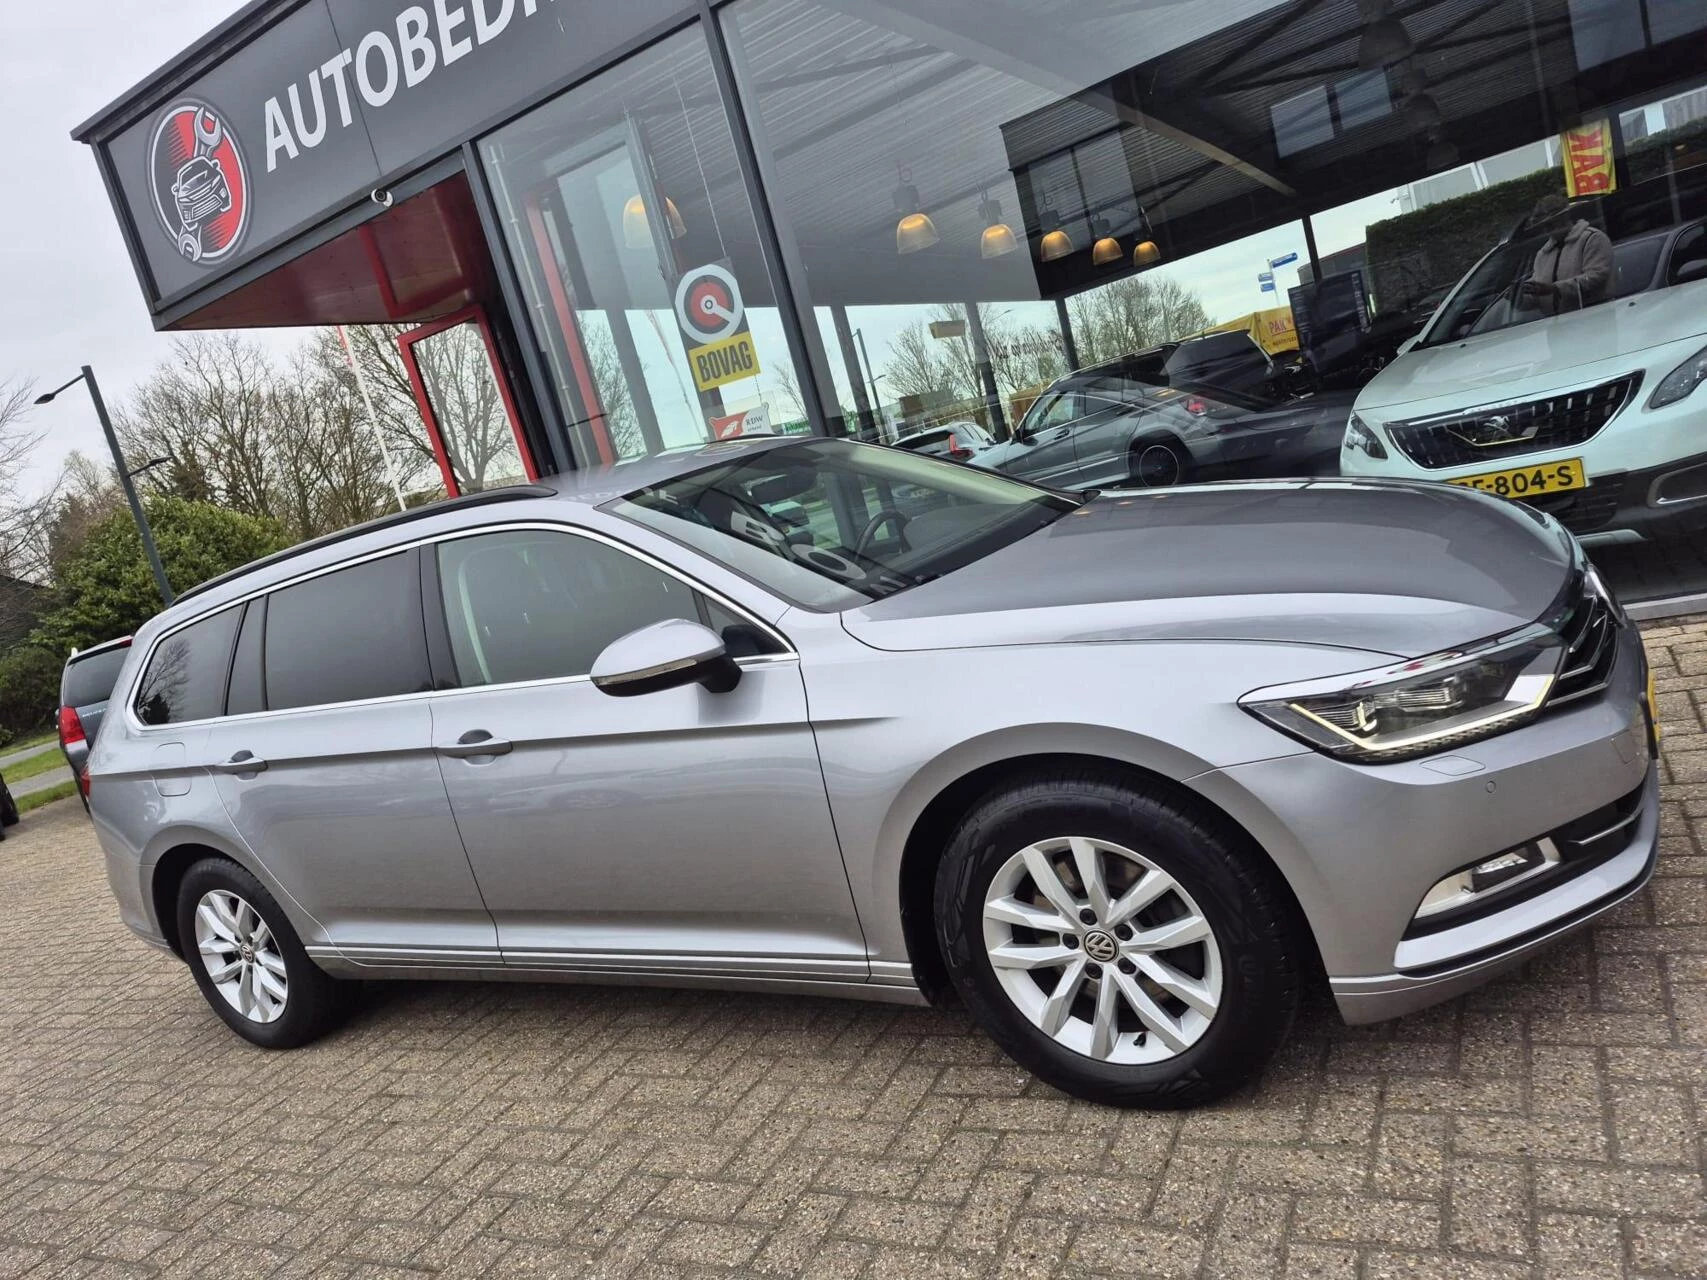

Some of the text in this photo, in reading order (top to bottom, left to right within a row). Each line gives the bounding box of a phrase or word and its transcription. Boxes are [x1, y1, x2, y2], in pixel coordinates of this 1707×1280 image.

[264, 0, 538, 172] AUTOBED
[696, 341, 753, 383] BOVAG
[1458, 465, 1573, 496] -804-S
